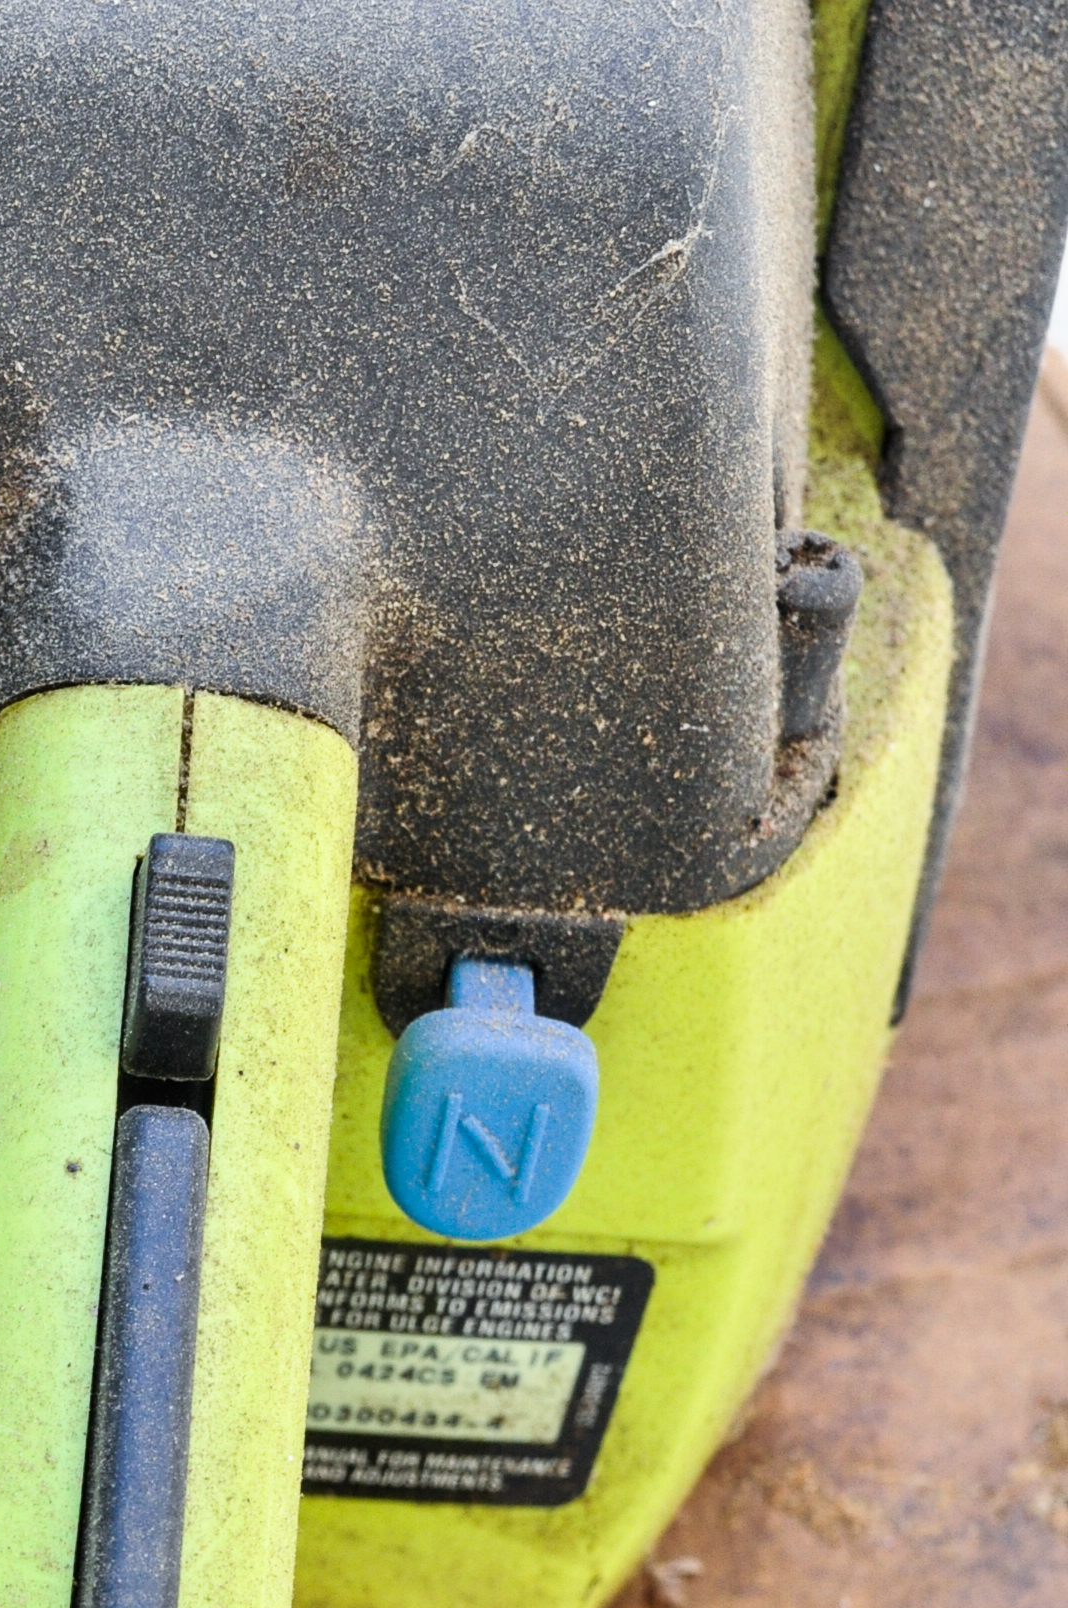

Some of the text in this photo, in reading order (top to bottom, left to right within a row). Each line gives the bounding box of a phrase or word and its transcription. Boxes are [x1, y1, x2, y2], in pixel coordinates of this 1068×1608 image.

[415, 1254, 594, 1284] INFORMATION
[407, 1274, 523, 1300] DIVISION
[530, 1281, 567, 1302] OF
[330, 1308, 382, 1330] FOR
[462, 1317, 573, 1341] ENGINES
[435, 1295, 467, 1317] TO
[474, 1298, 616, 1325] EMISSIONS
[318, 1335, 358, 1356] US
[375, 1448, 422, 1469] FOR
[423, 1452, 573, 1479] MAINTENANCE
[349, 1466, 504, 1492] ADJUSTMENTS
